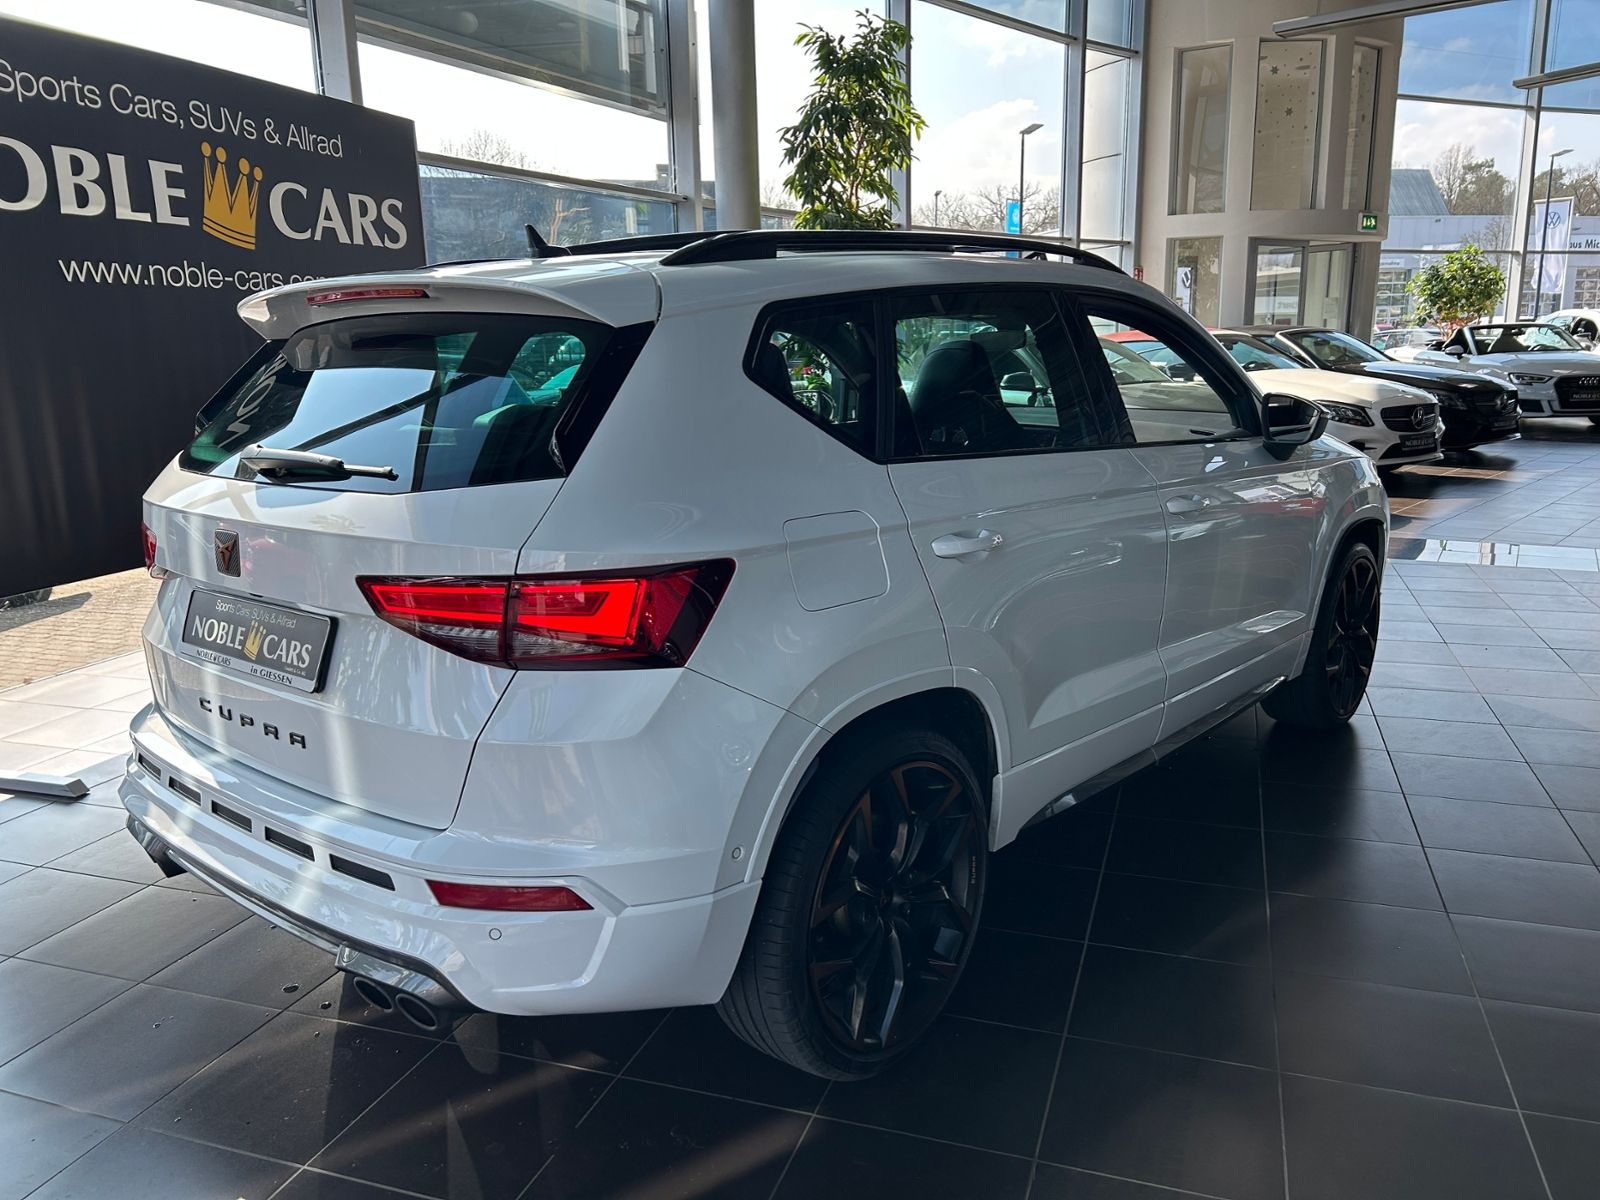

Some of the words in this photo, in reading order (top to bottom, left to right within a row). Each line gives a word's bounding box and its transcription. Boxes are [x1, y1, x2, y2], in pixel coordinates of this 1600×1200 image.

[0, 59, 101, 109] Sports
[109, 83, 184, 129] Cars,
[188, 100, 257, 140] SUVs
[263, 118, 281, 146] &
[287, 123, 343, 158] Allrad
[269, 181, 408, 250] CARS
[215, 599, 235, 613] Sports
[251, 608, 270, 622] SUVs
[276, 613, 297, 628] Allrad
[191, 615, 246, 650] NOBLE
[263, 634, 312, 668] CARS
[196, 649, 214, 661] NOBLE
[217, 655, 232, 666] CARS
[250, 665, 258, 674] in
[259, 668, 293, 685] GIESSEN
[198, 697, 307, 749] CUPRA
